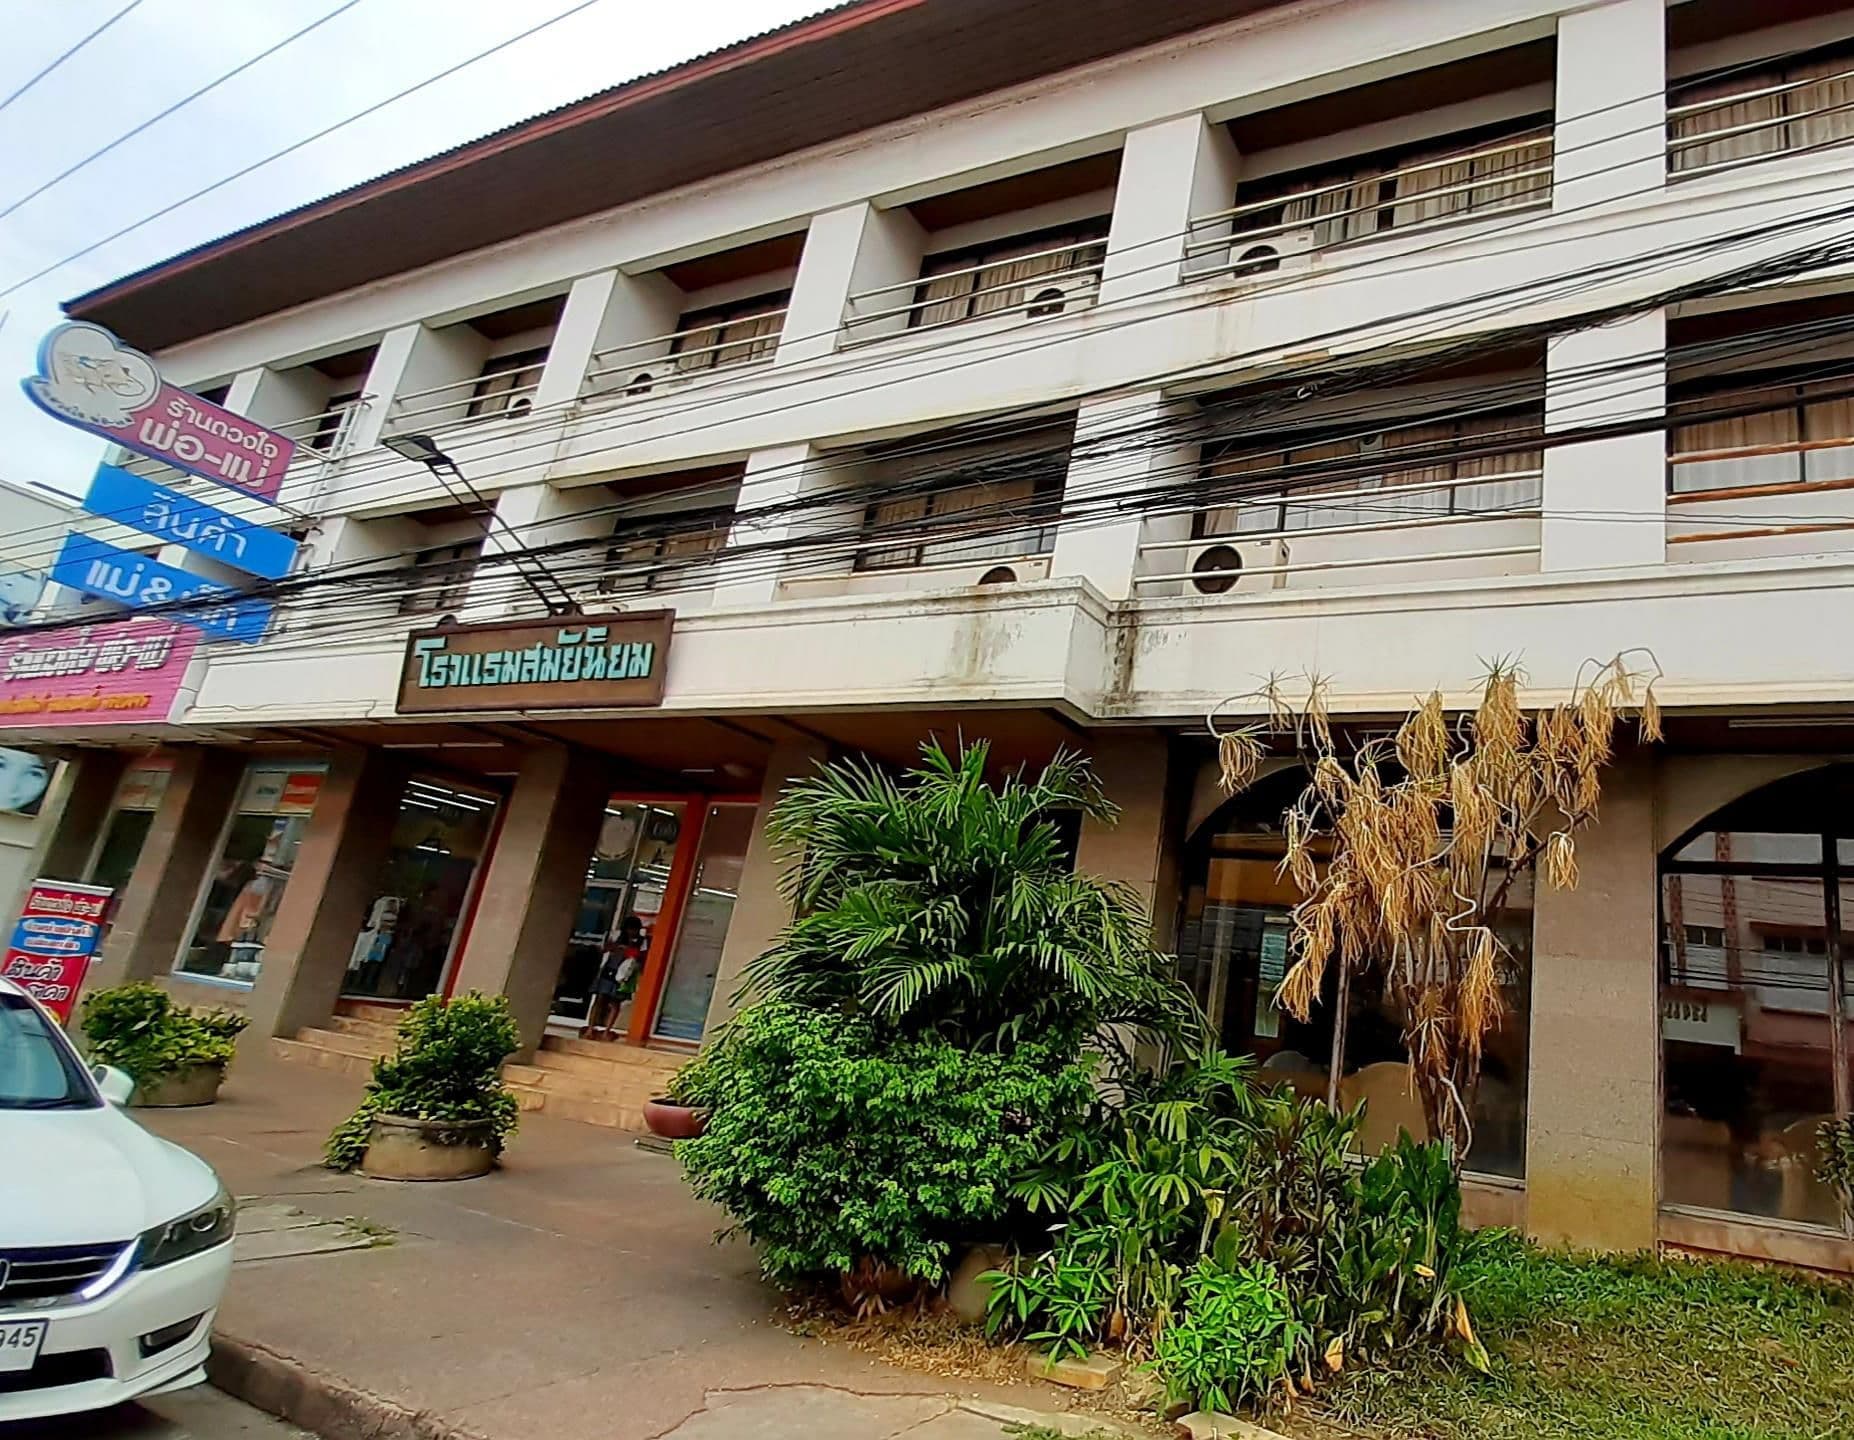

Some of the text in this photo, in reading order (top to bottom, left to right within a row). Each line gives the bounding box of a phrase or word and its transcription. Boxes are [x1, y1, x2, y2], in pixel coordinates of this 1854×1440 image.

[139, 418, 271, 488] พ่อ-แม่
[144, 492, 248, 559] สินค้า
